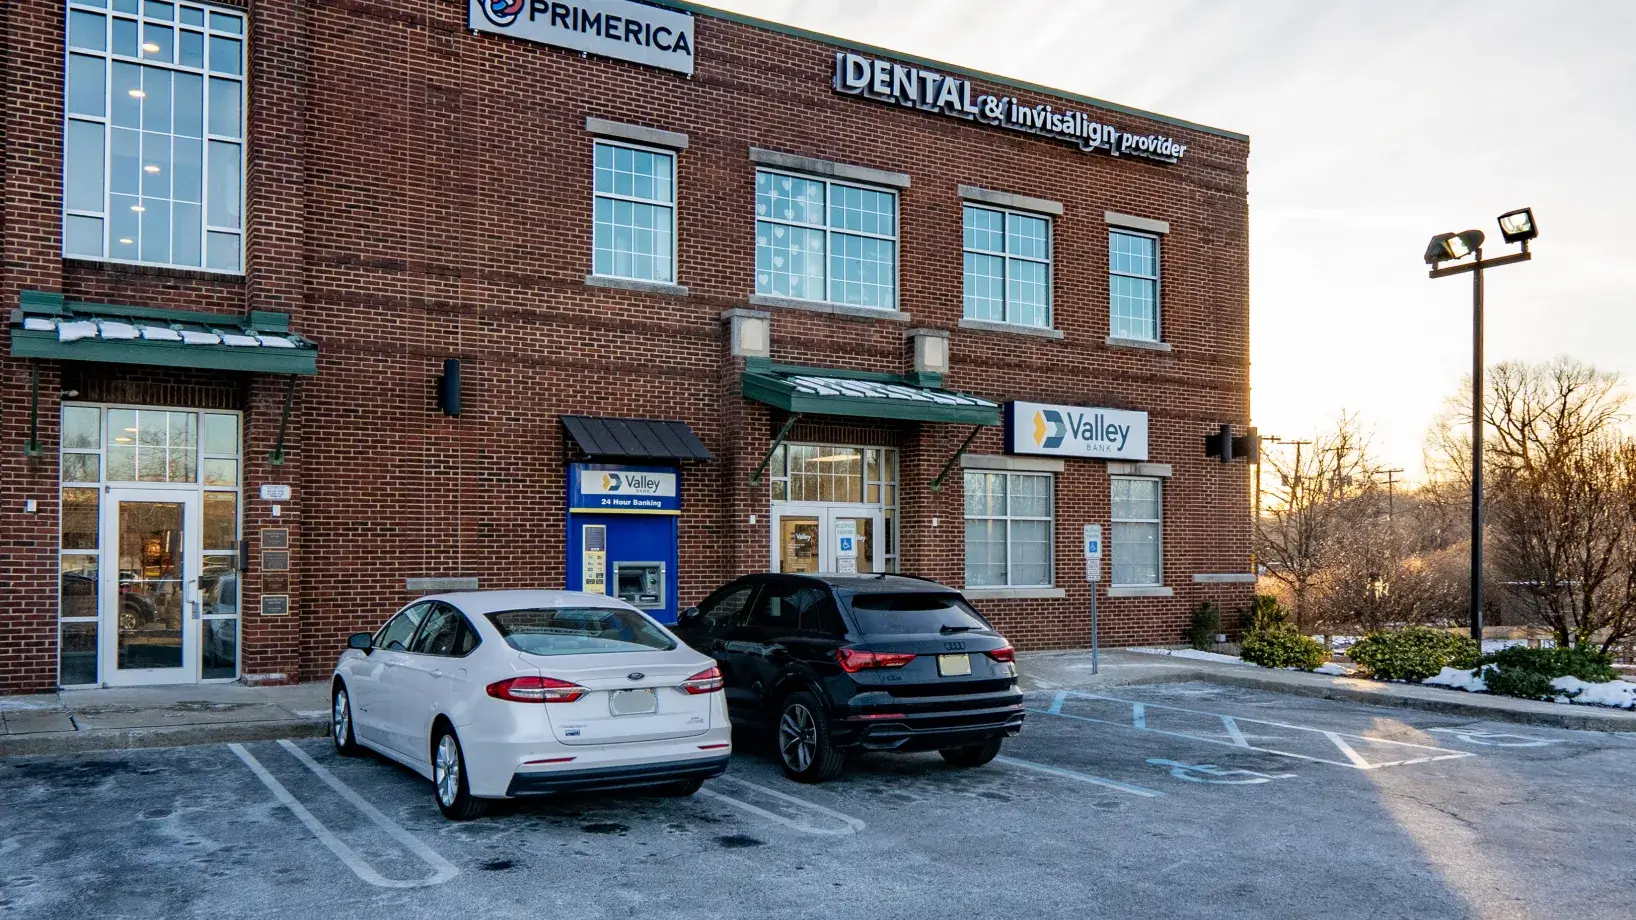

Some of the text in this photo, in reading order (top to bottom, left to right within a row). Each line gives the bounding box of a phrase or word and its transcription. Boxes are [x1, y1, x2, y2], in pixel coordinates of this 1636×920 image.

[529, 0, 692, 56] PRIMERICA
[845, 52, 1187, 158] DENTAL & invisalign provider
[1067, 411, 1131, 451] Valley
[1086, 443, 1112, 453] BANK
[625, 475, 661, 493] Valley
[633, 499, 662, 508] Banking
[795, 533, 811, 541] Valley
